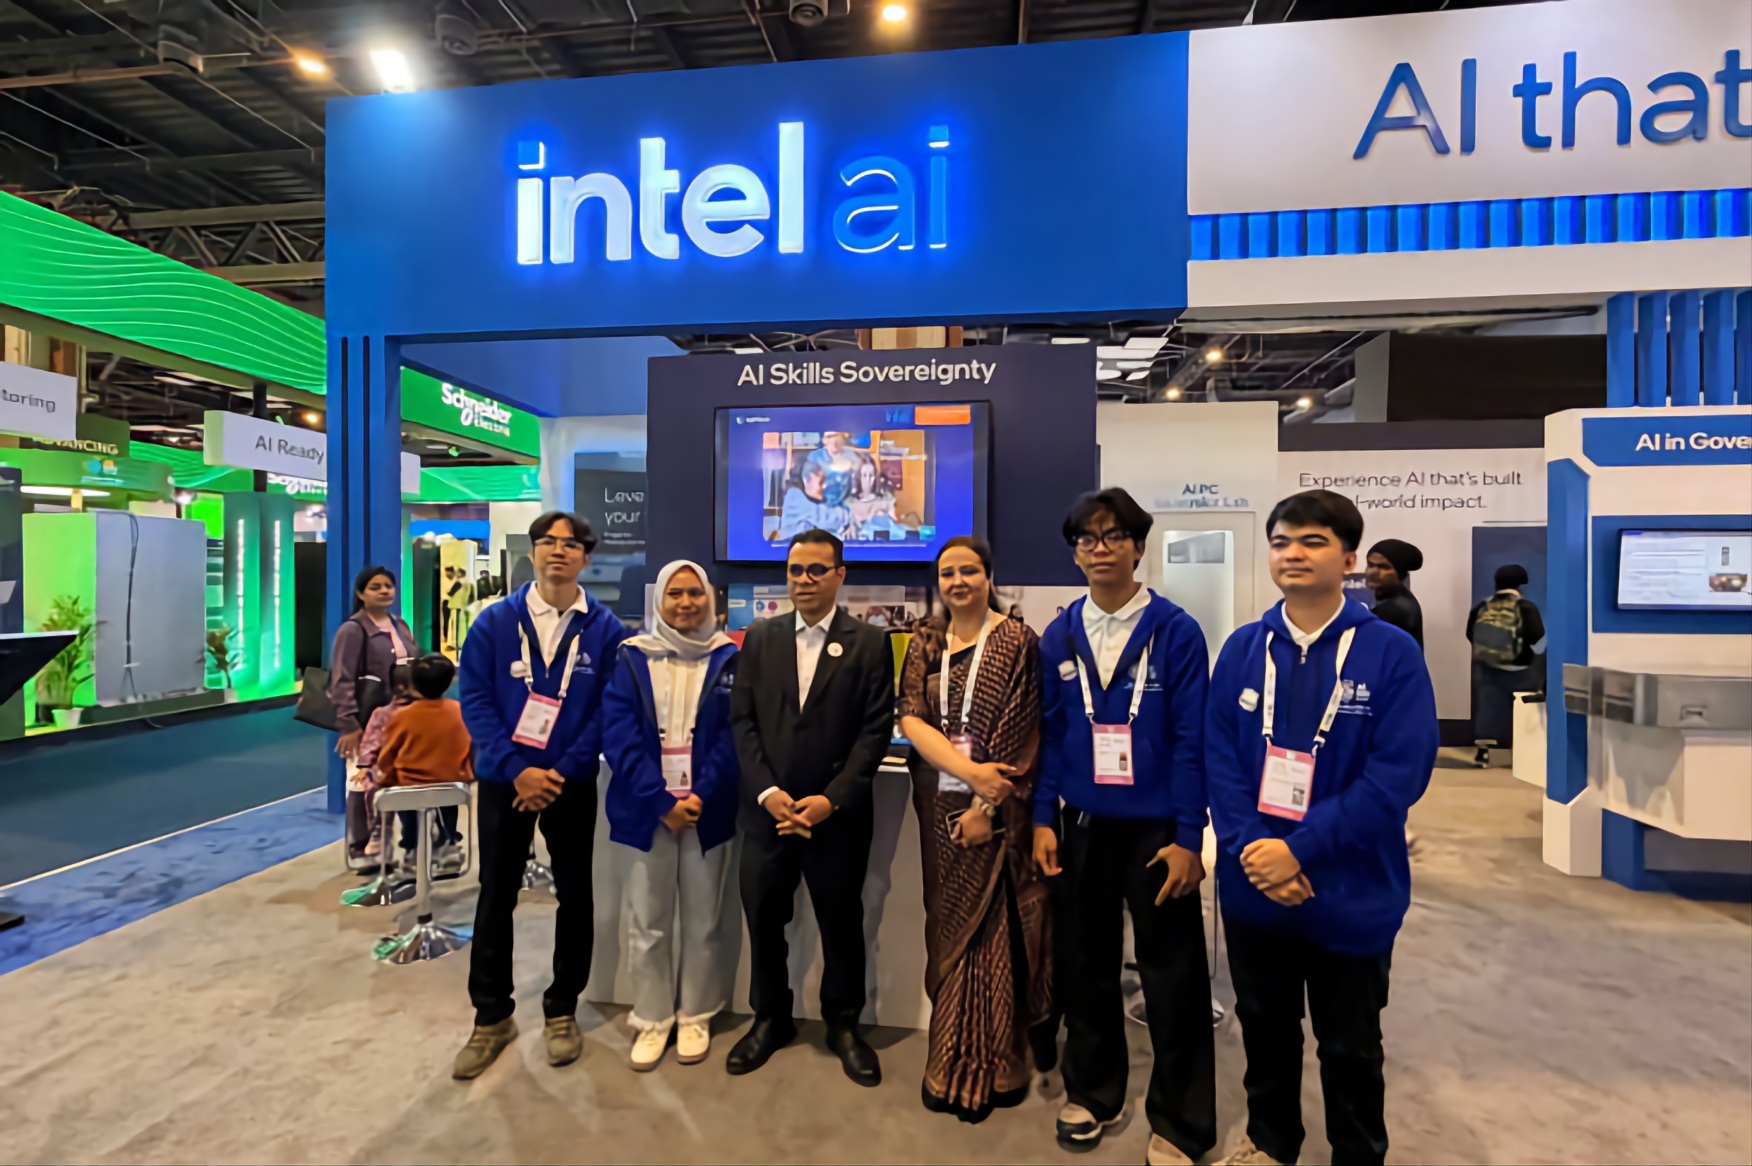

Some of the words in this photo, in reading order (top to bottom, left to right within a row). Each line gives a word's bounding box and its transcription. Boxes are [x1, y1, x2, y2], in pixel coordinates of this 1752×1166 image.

[1353, 58, 1477, 160] AI
[1511, 49, 1752, 152] that
[517, 122, 804, 265] intel
[833, 125, 950, 254] ai
[738, 364, 764, 386] AI
[770, 362, 835, 385] Skills
[839, 358, 996, 385] Sovereignty
[255, 435, 272, 451] AI
[277, 438, 325, 465] Ready
[1636, 433, 1660, 451] AI
[1665, 432, 1685, 450] in
[1200, 484, 1219, 495] PC
[1299, 472, 1400, 490] Experience
[1405, 471, 1425, 487] AI
[1430, 470, 1478, 486] that's
[1483, 471, 1522, 486] built
